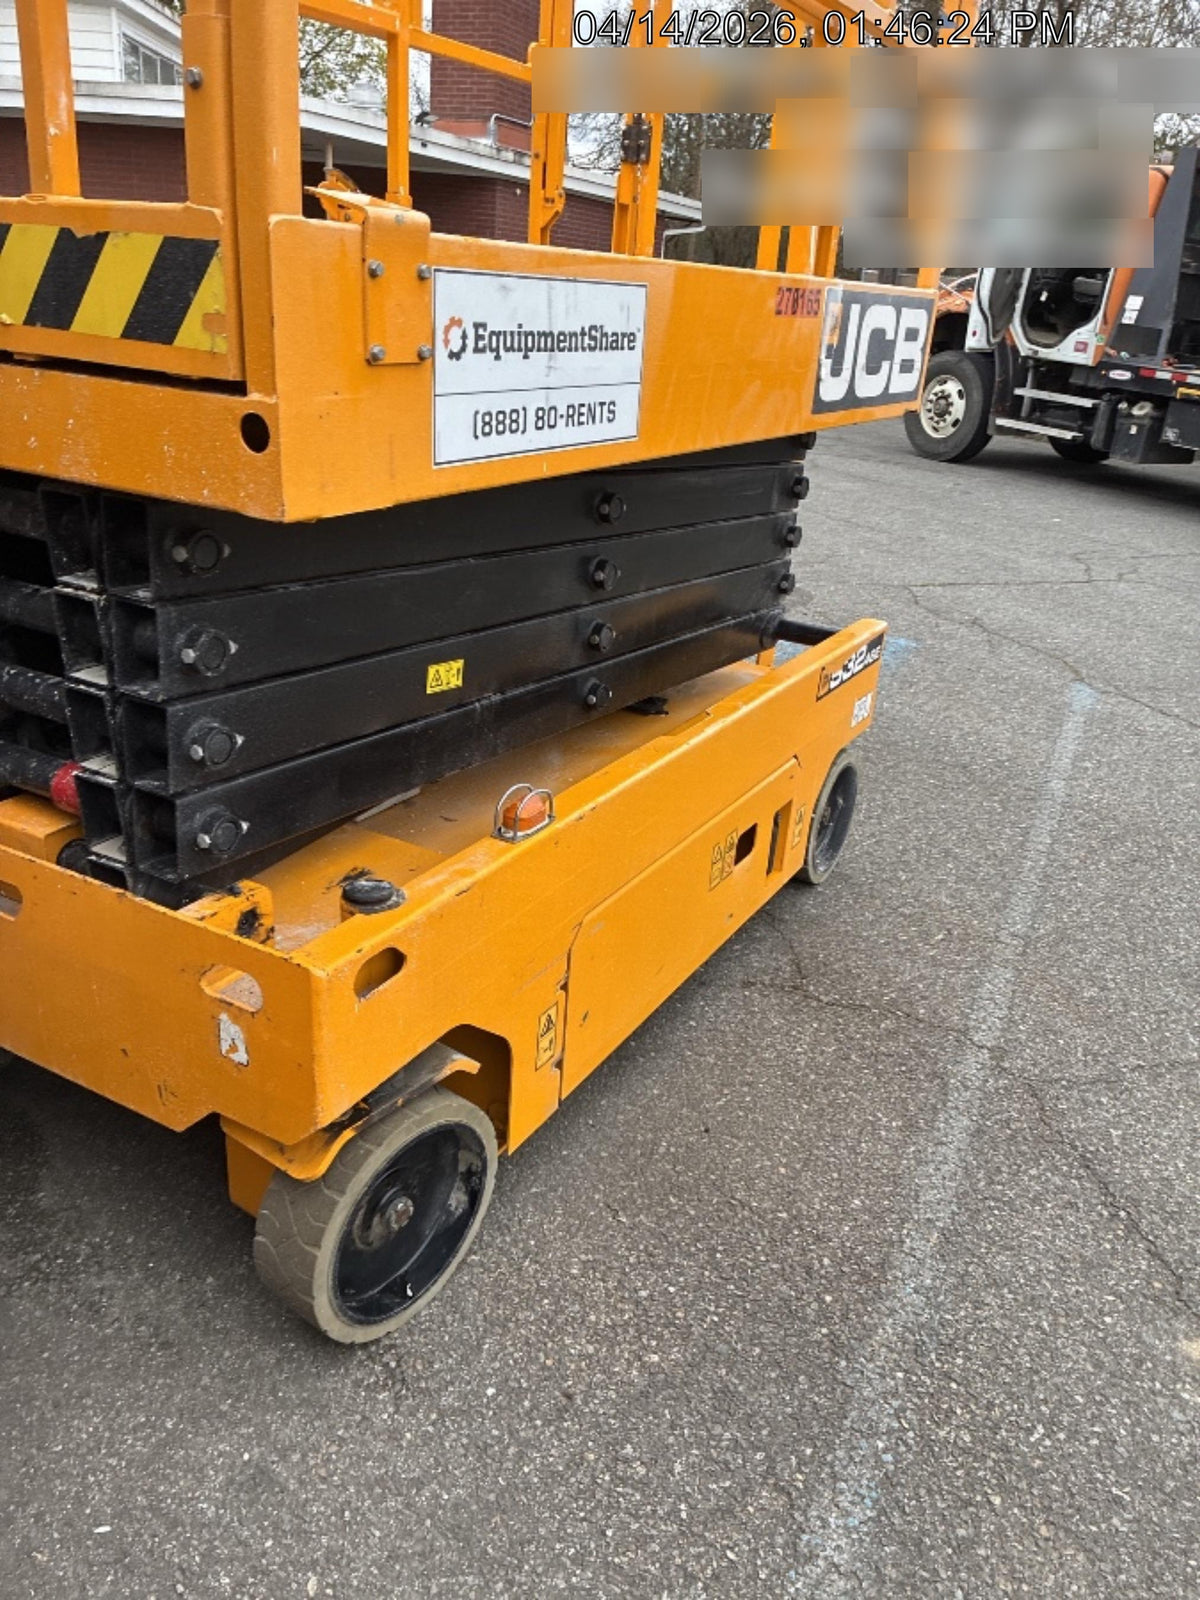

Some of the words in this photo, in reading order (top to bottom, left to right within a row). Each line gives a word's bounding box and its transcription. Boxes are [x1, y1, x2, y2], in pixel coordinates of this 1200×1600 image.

[819, 303, 929, 402] JCB
[473, 406, 527, 440] (888)
[534, 401, 616, 431] 80-RENTS
